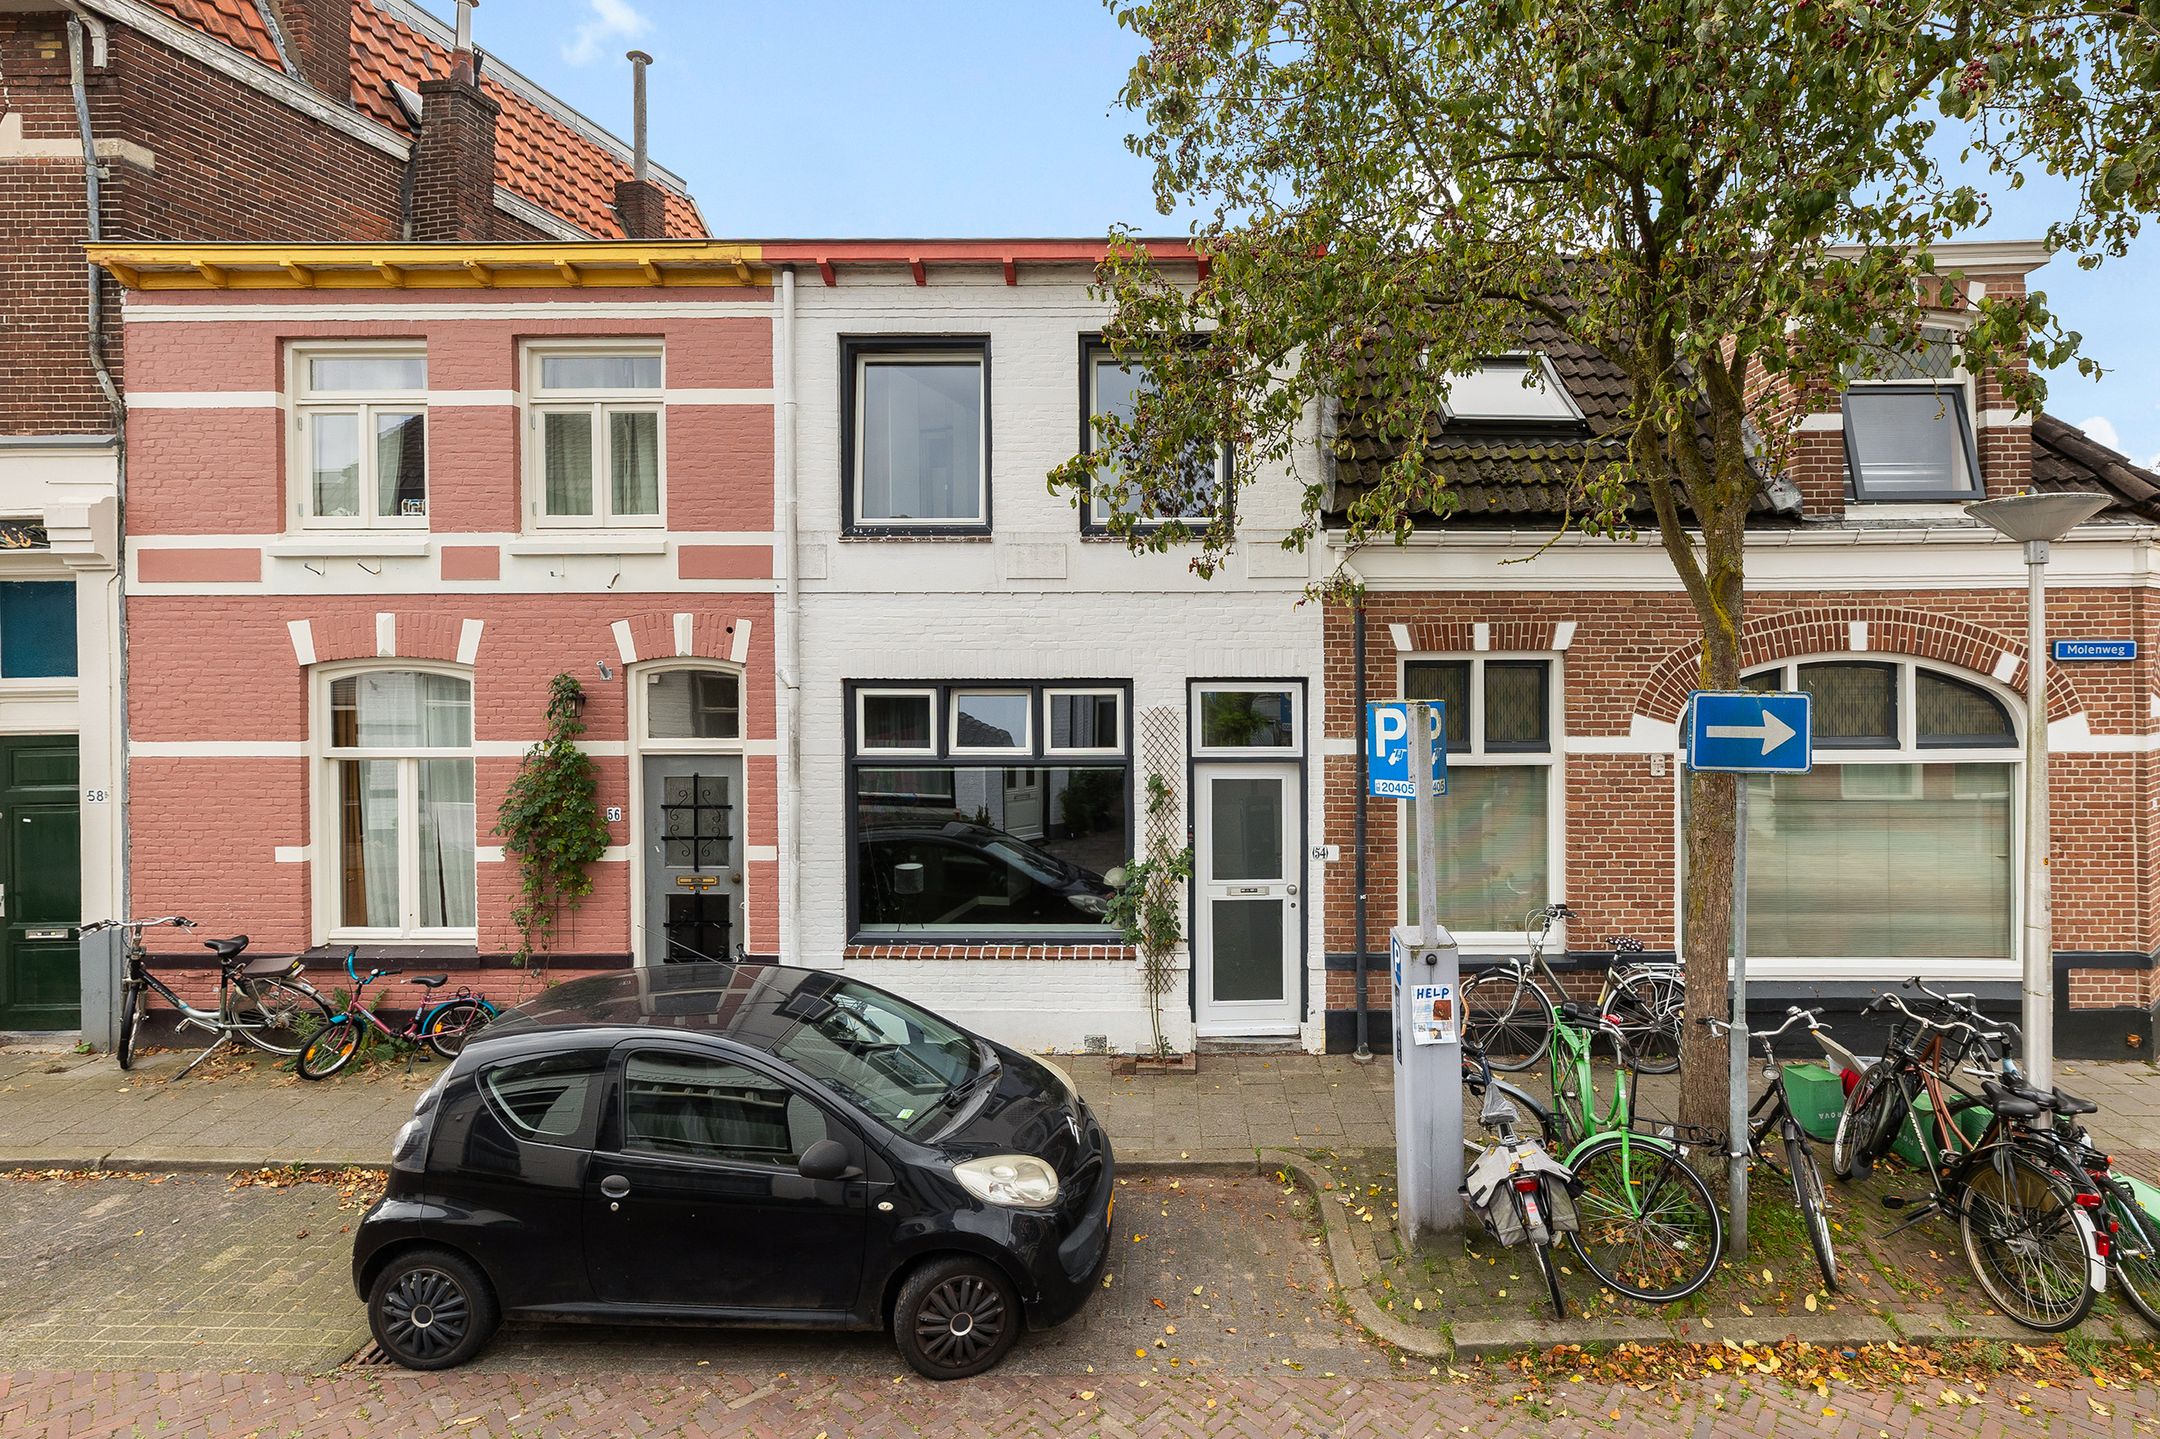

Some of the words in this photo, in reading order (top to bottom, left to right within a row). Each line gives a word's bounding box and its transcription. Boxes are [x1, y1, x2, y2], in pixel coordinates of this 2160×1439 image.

[2067, 644, 2126, 656] Molenweg
[1375, 708, 1406, 757] P
[1381, 782, 1415, 794] 20405
[607, 809, 620, 821] 56
[1416, 987, 1450, 999] HELP
